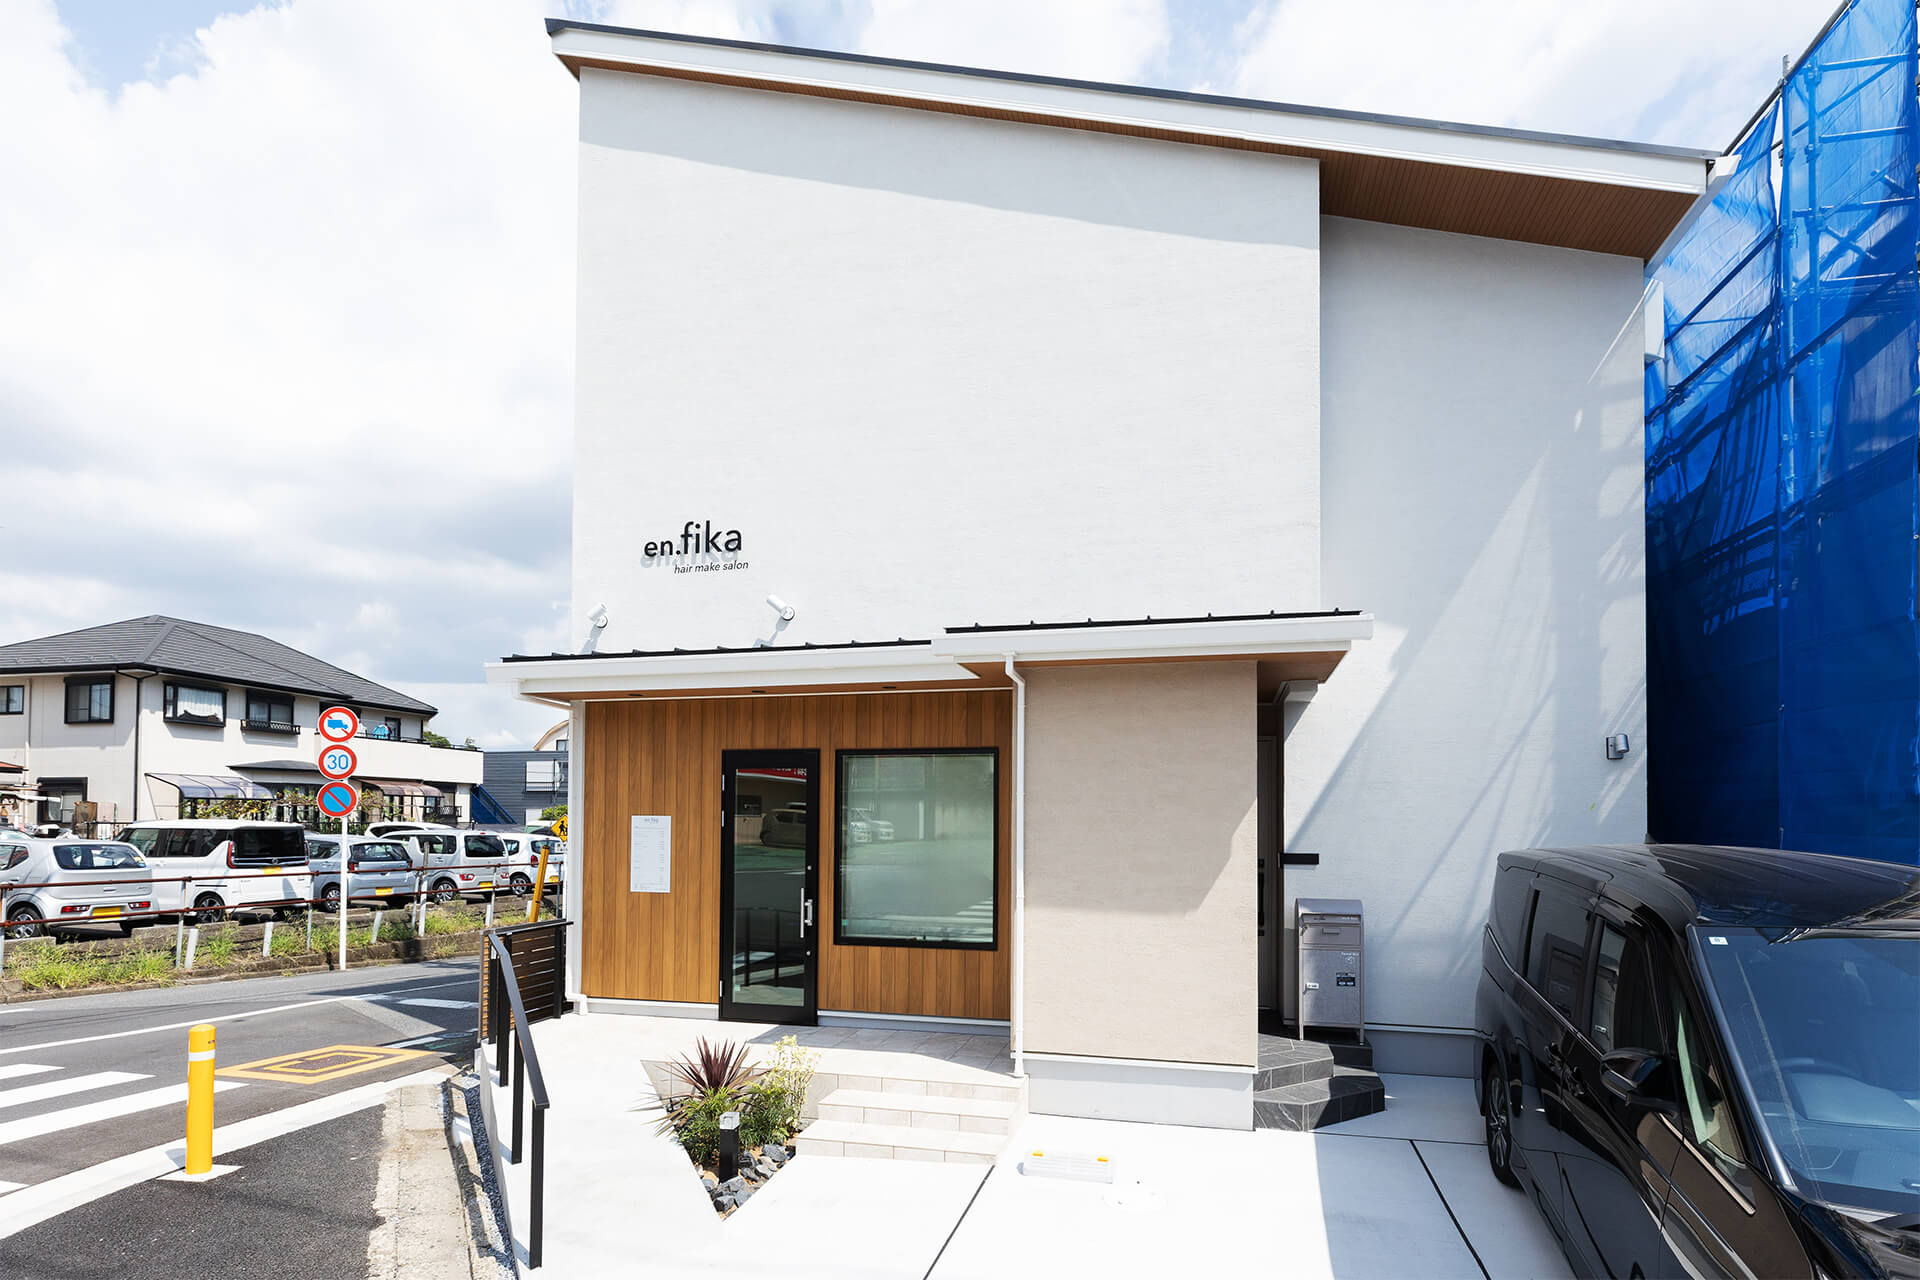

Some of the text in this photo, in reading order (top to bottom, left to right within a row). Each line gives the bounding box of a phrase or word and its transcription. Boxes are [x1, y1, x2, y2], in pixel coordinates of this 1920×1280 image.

[644, 520, 742, 557] en.fika
[674, 560, 749, 574] hair make salon
[327, 754, 349, 770] 30
